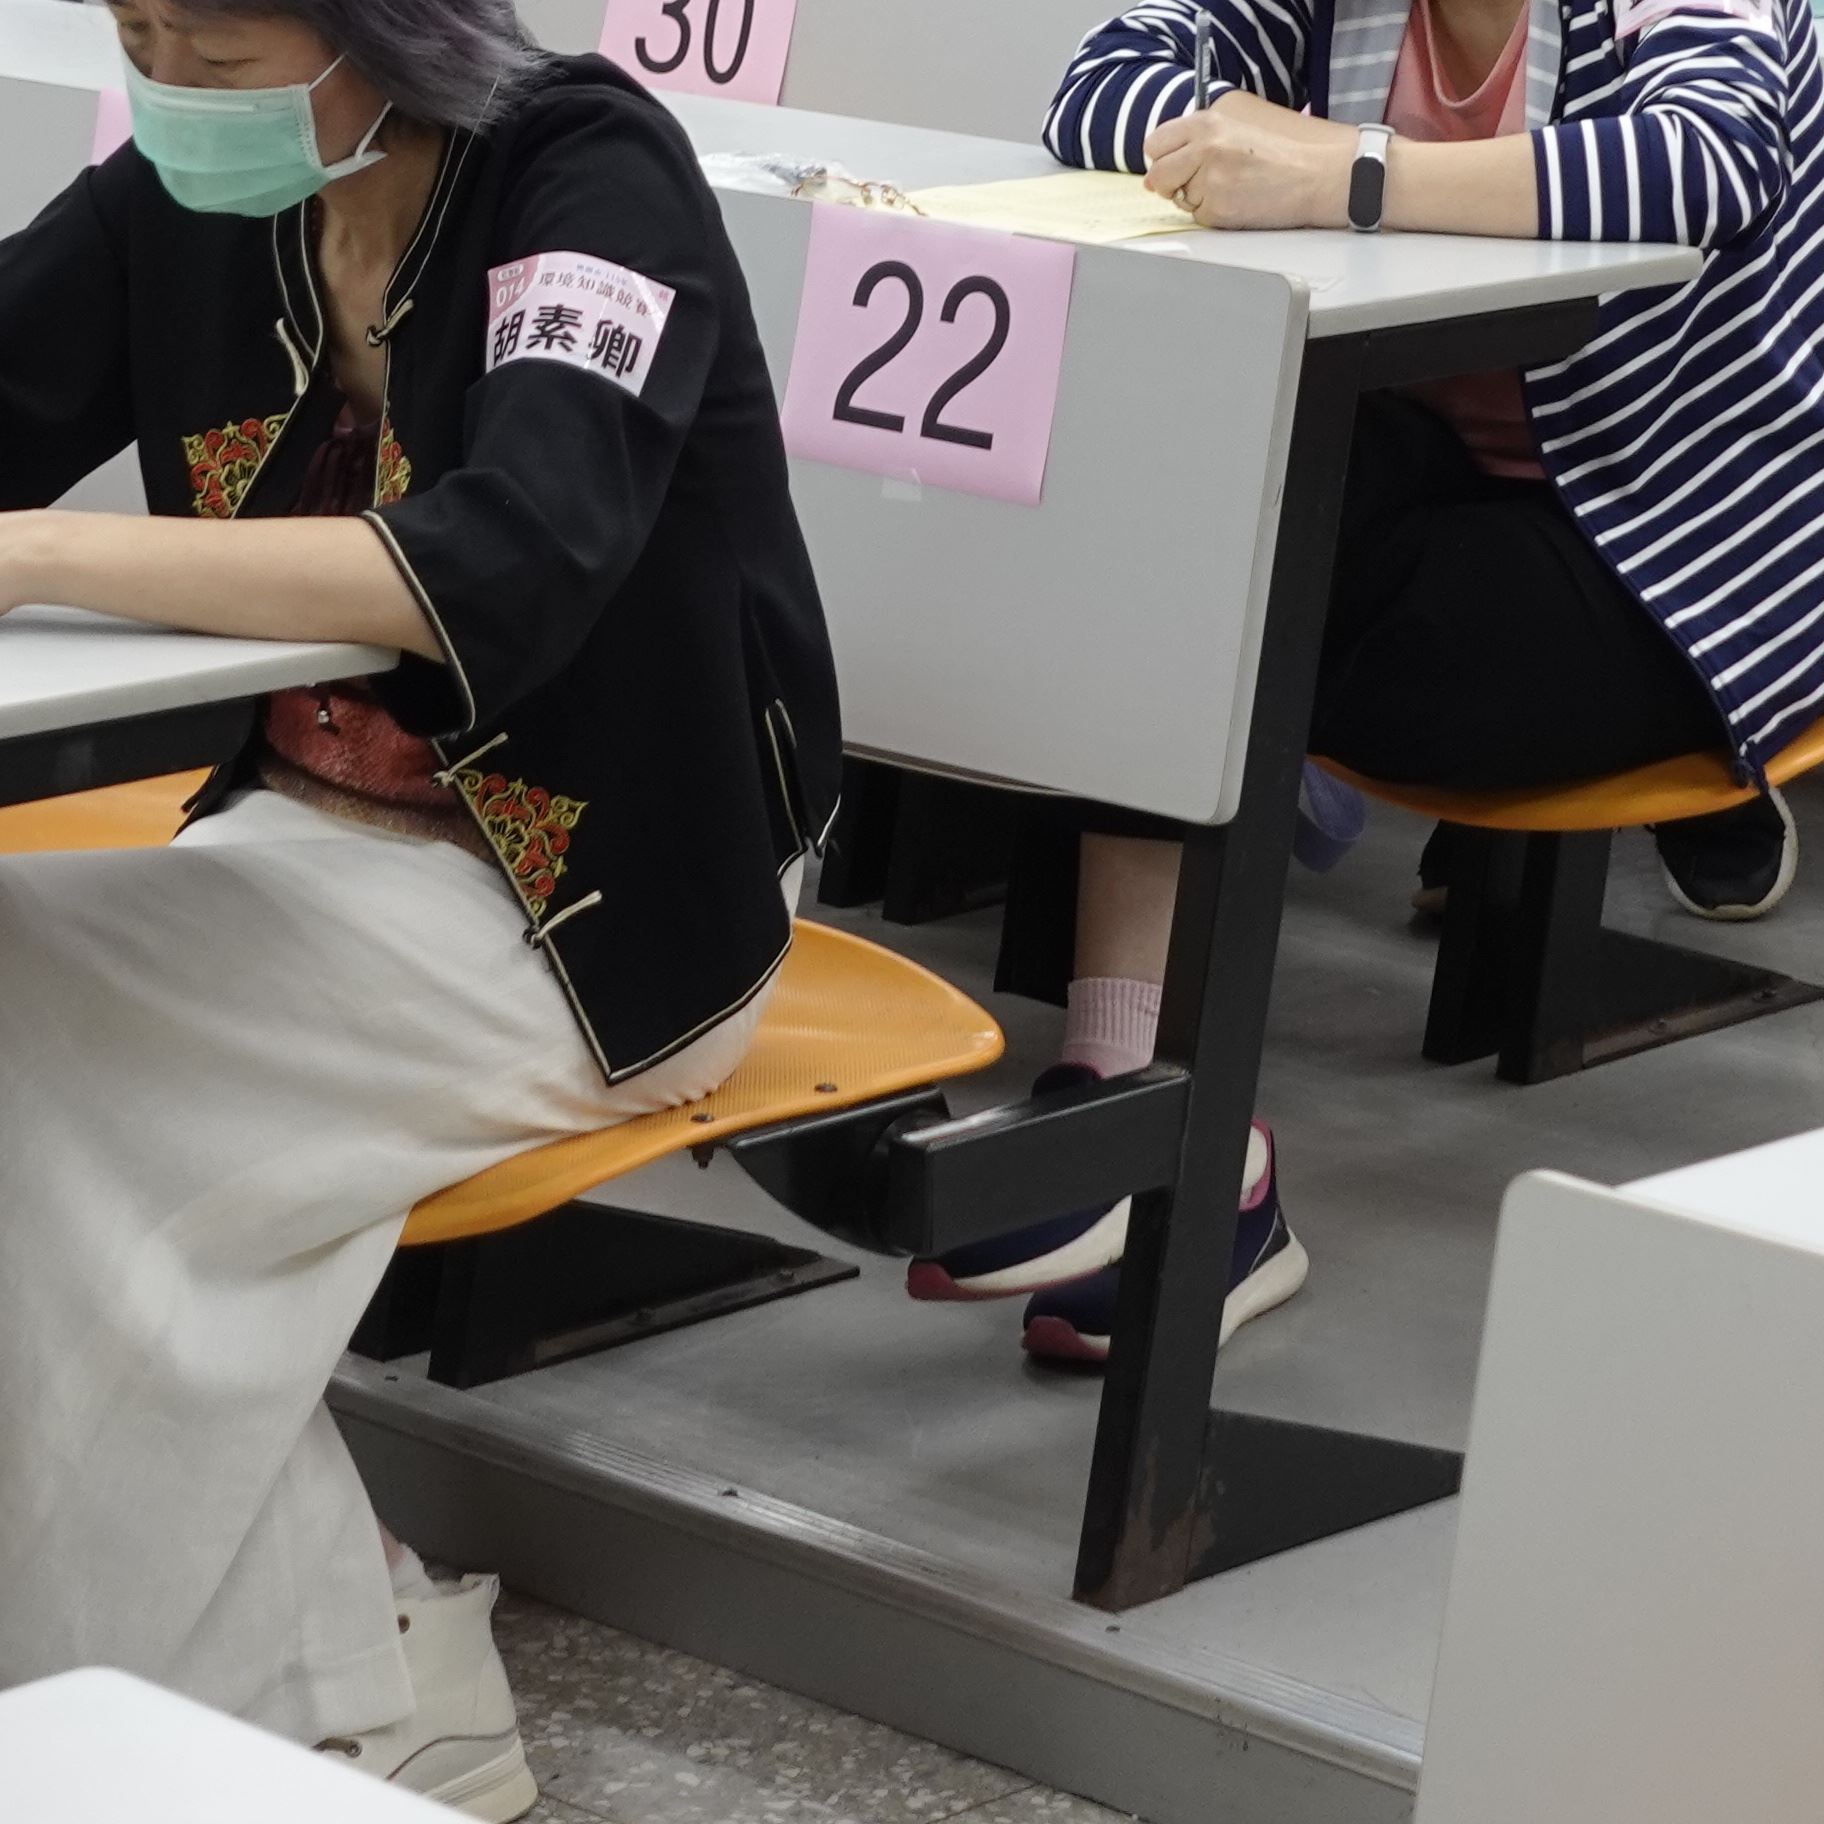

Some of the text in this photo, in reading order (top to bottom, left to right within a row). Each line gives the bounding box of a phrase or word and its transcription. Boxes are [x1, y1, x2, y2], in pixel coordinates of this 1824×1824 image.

[496, 278, 526, 308] 014
[494, 304, 644, 379] 胡素卿
[832, 260, 1011, 451] 22
